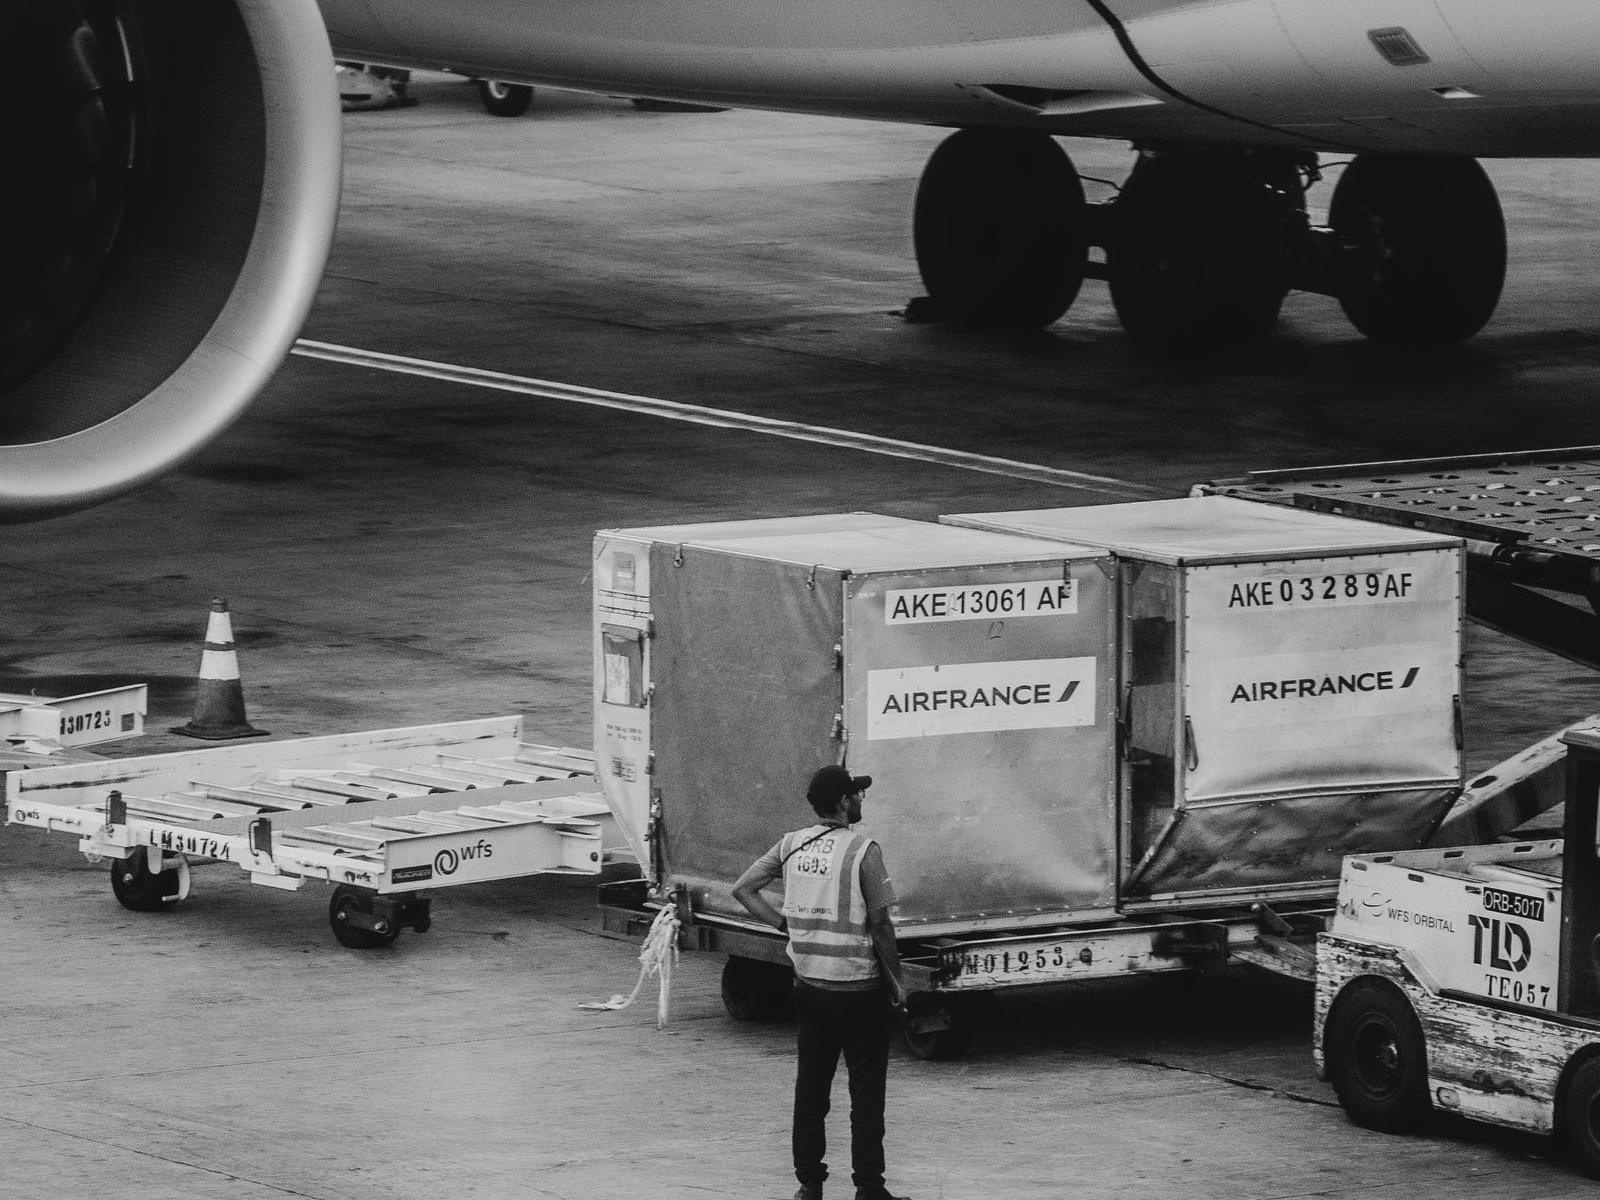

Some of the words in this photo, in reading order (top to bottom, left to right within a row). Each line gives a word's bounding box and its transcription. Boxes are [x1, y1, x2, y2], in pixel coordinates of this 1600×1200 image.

[892, 592, 947, 619] AKE
[956, 588, 1026, 614] 13061
[1037, 585, 1071, 610] AF
[881, 684, 1051, 714] AIRFRANCE
[1231, 671, 1394, 703] AIRFRANCE
[460, 839, 493, 861] wfs
[1484, 889, 1544, 919] ORB-5017
[1387, 907, 1409, 923] WFS
[1414, 913, 1456, 933] ORBITAL
[1468, 914, 1532, 973] TLD
[1485, 973, 1550, 1008] TE057
